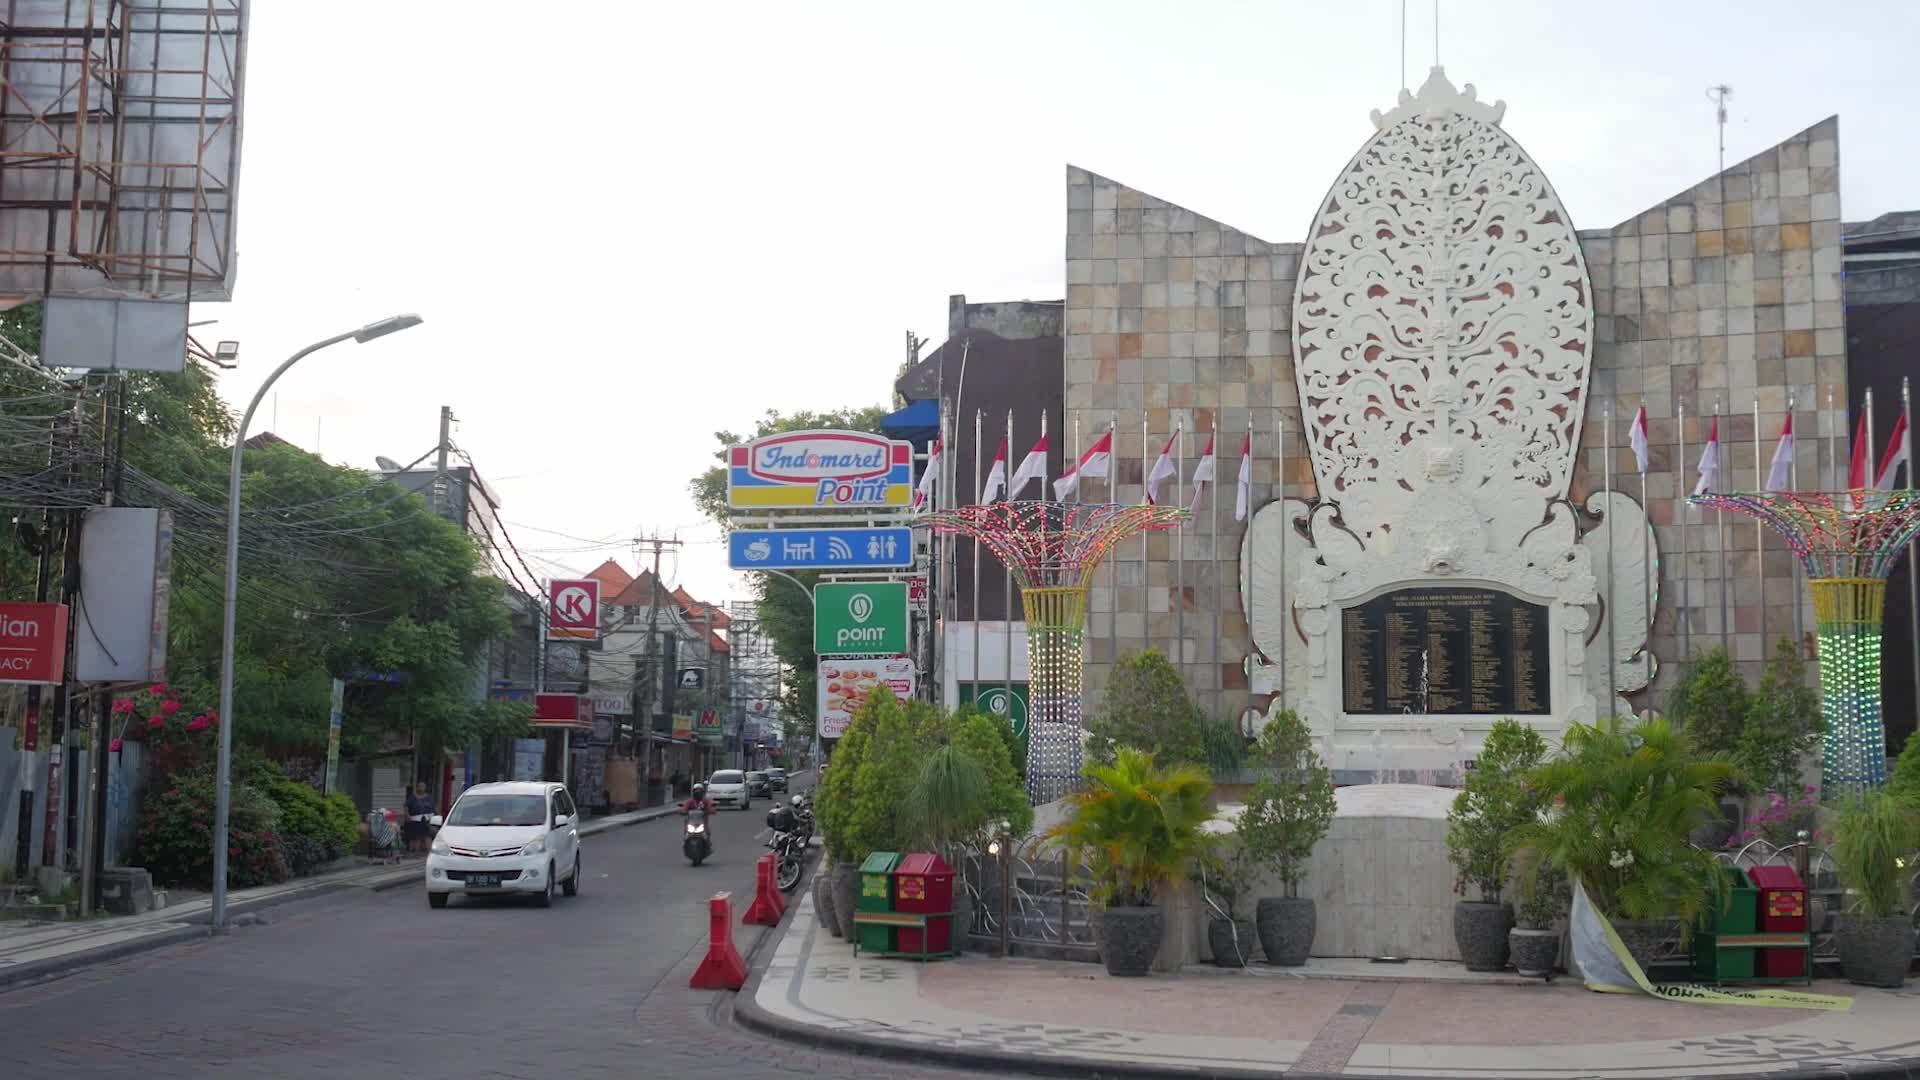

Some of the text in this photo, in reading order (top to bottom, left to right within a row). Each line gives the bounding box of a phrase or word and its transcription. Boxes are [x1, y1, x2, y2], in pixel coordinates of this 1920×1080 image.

[761, 446, 882, 469] Indomaret
[816, 478, 887, 504] Point
[0, 657, 32, 671] ACY
